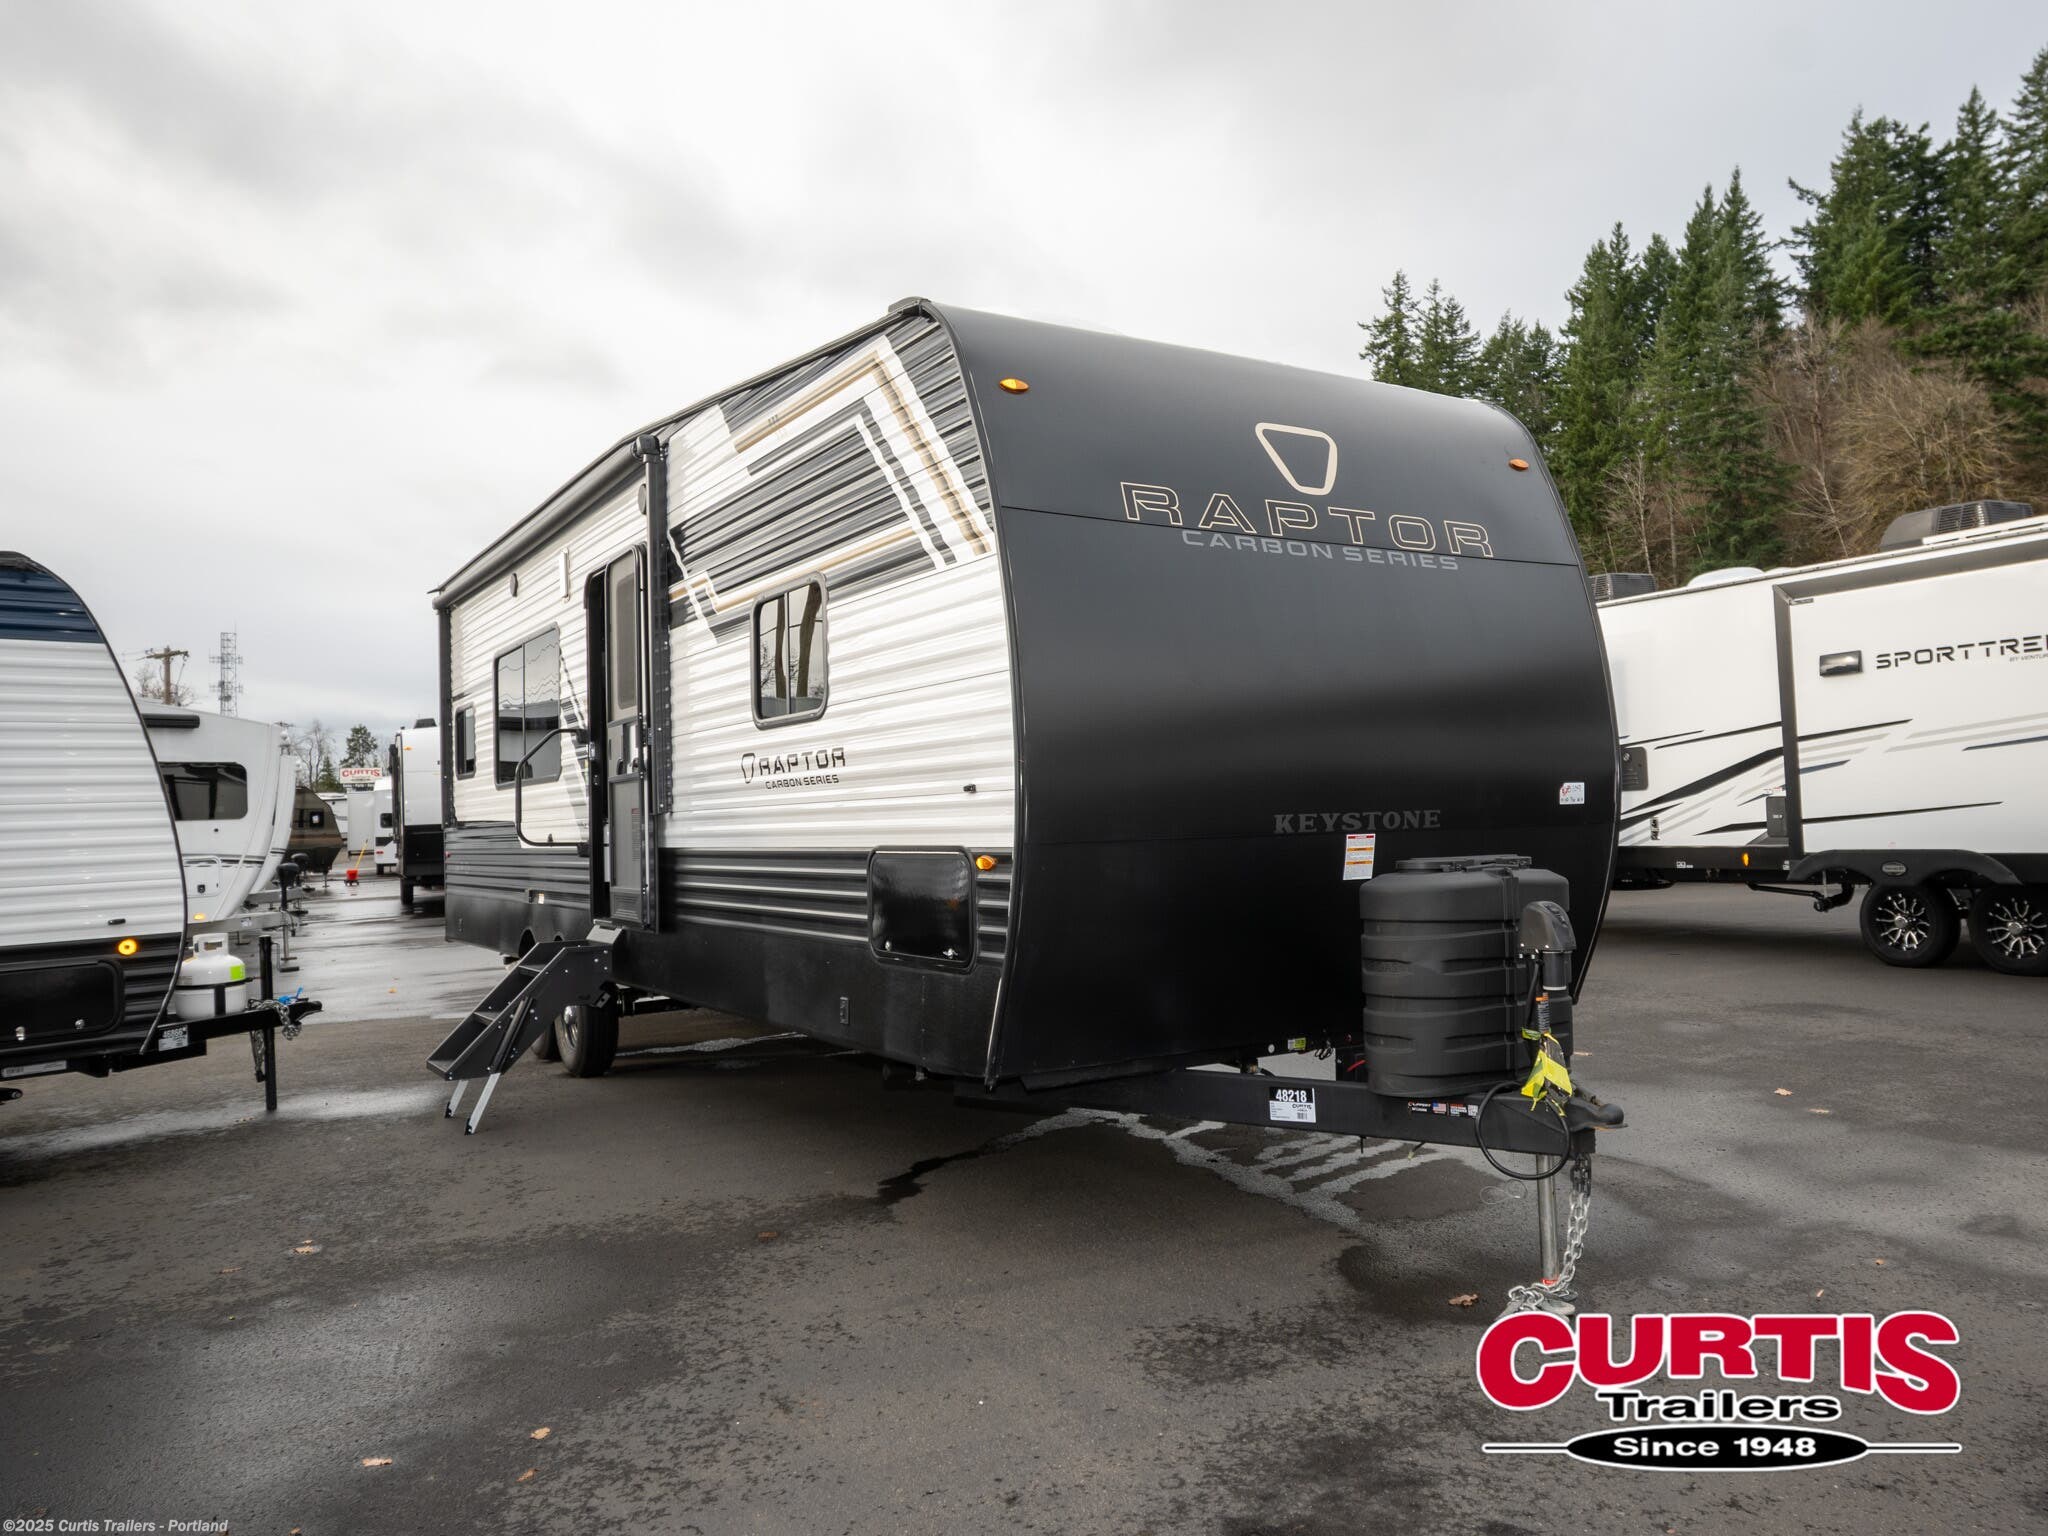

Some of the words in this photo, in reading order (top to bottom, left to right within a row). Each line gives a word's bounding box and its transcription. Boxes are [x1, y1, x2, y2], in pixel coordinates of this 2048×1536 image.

[1120, 481, 1494, 558] RAPTOR
[1181, 530, 1333, 560] CARBON
[1345, 546, 1459, 571] SERIES
[1876, 634, 2048, 669] SPORTTRE
[342, 769, 380, 777] CURTIS
[759, 747, 846, 776] RAPTOR
[765, 778, 802, 790] CARBON
[803, 774, 840, 786] SERIES
[1273, 809, 1441, 834] KEYSTONE
[1275, 1089, 1307, 1103] 48218
